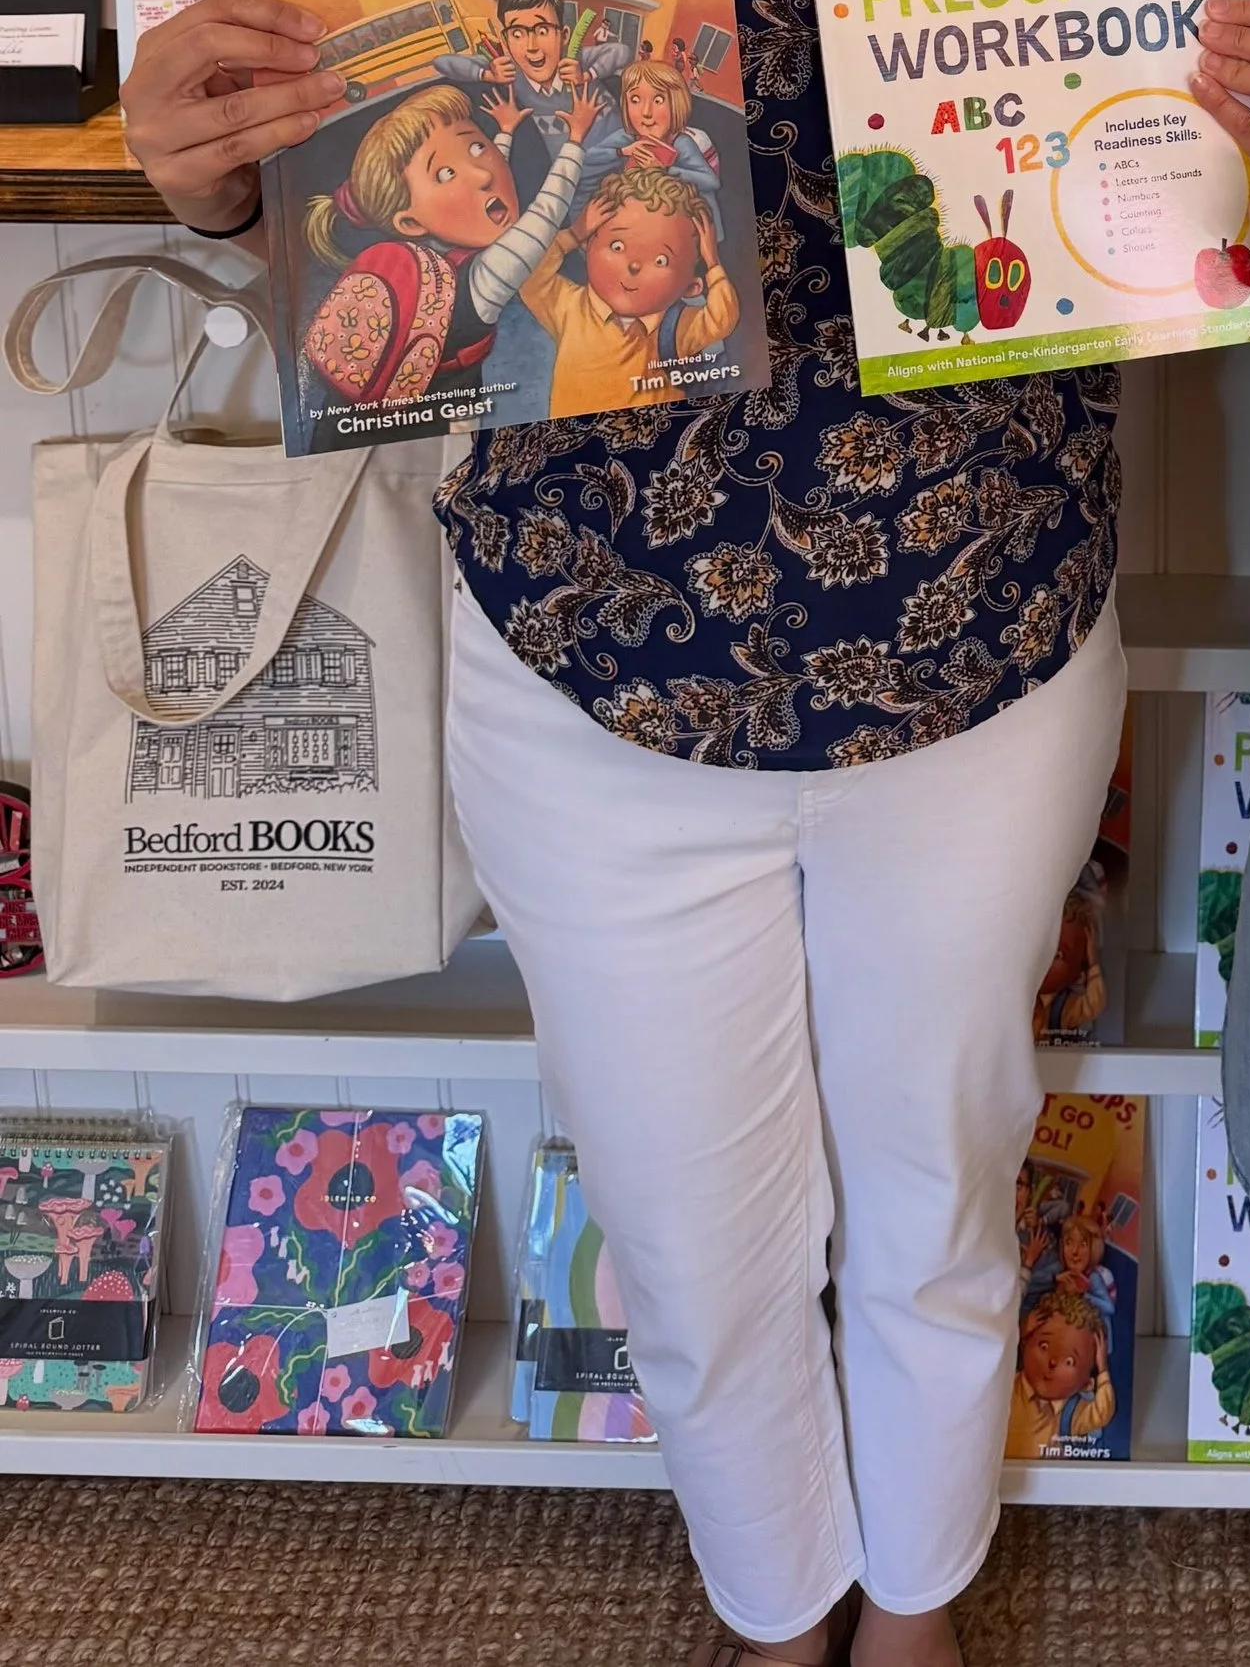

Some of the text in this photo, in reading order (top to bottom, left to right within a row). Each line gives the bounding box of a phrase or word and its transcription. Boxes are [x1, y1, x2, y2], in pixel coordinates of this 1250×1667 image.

[931, 92, 1026, 135] ABC
[1105, 113, 1187, 134] Includes Key
[1094, 129, 1202, 152] Readiness Skills:
[995, 131, 1070, 174] 123
[1114, 159, 1140, 170] ABCs
[1115, 168, 1202, 187] Letters and Sounds
[1117, 192, 1160, 203] Numbers
[1120, 208, 1162, 220] Counting
[648, 352, 717, 371] illustrated by
[887, 361, 924, 378] Aligns
[927, 356, 953, 372] with
[956, 349, 1005, 368] National
[1008, 335, 1112, 363] Pre-Kindergarten
[1114, 332, 1144, 350] Early
[629, 363, 741, 392] Tim Bowers
[309, 380, 517, 421] by New York Times bestselling author
[337, 398, 494, 435] Christina Geist
[124, 820, 375, 855] Bedford BOOKS
[124, 862, 374, 874] INDEPENDENT BOOKSTORE BEDFORD, NEW YORK
[220, 879, 285, 891] EST. 2024
[1060, 1108, 1094, 1131] GO
[72, 1343, 101, 1351] JOTTER
[576, 1372, 635, 1381] SPIRAL BOUND
[1087, 1435, 1097, 1445] by
[1038, 1443, 1111, 1459] Tim Bowers
[1207, 1449, 1234, 1461] Aligns
